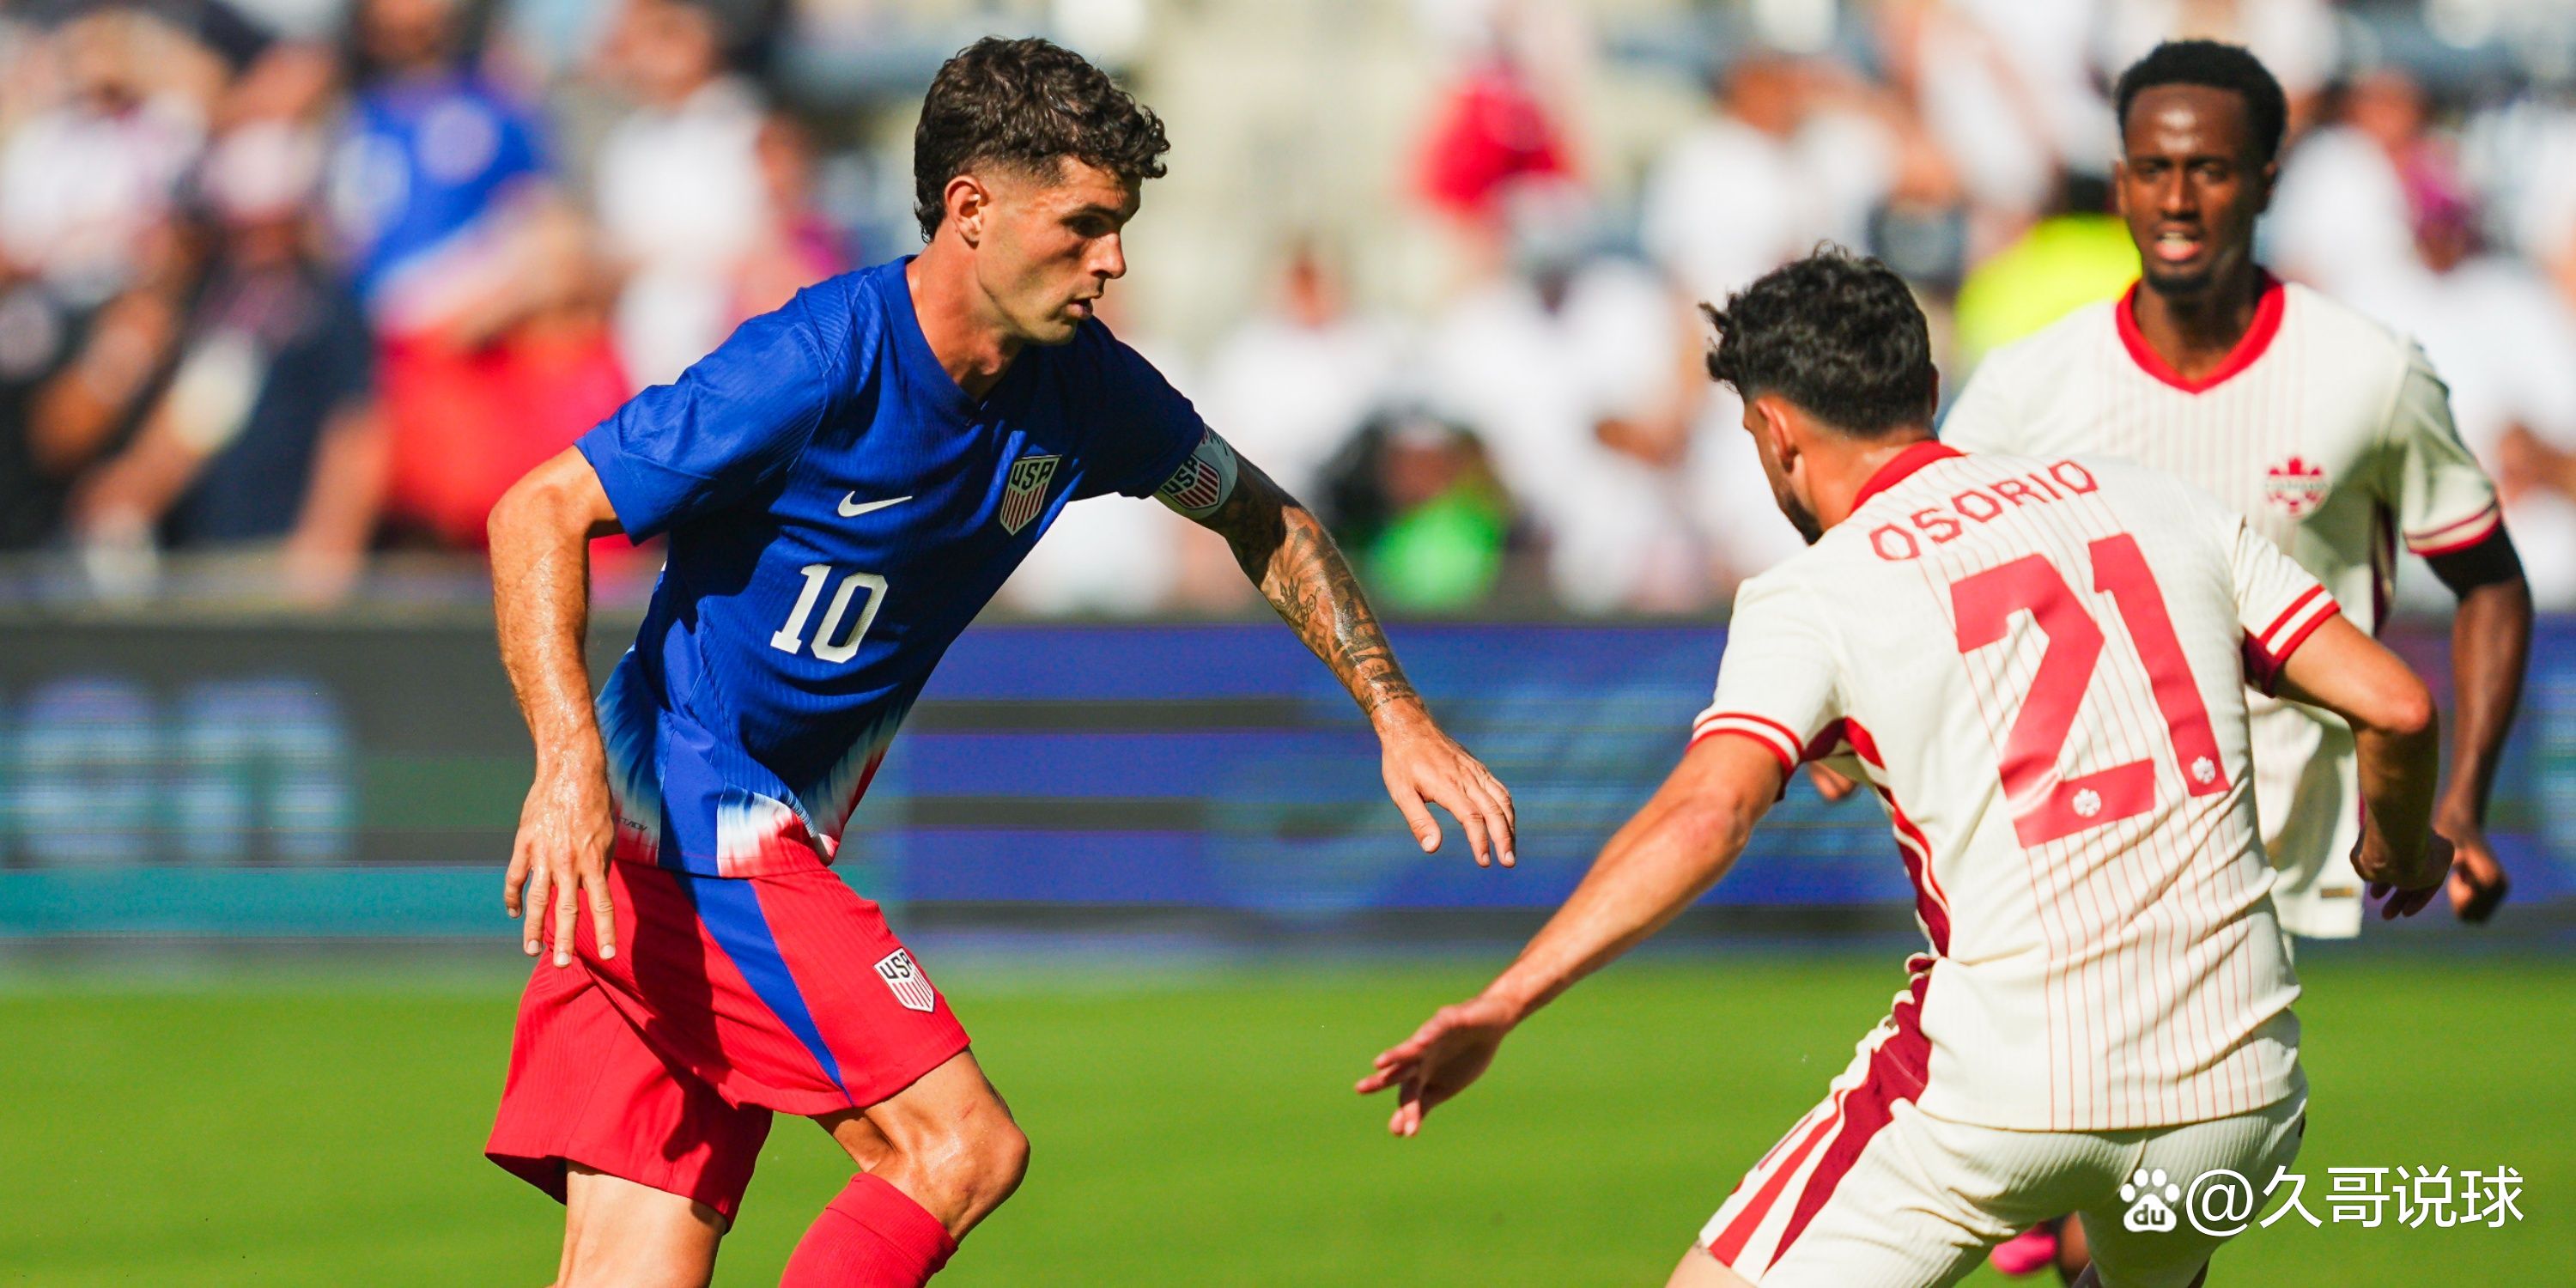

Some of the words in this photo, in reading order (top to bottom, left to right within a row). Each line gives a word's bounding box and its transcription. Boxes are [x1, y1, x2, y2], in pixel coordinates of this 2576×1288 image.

[1012, 460, 1055, 490] USA
[1162, 457, 1199, 494] USA
[1868, 459, 2099, 561] OSORIO
[769, 563, 889, 664] 10
[1949, 532, 2232, 850] 21
[879, 951, 912, 979] USA
